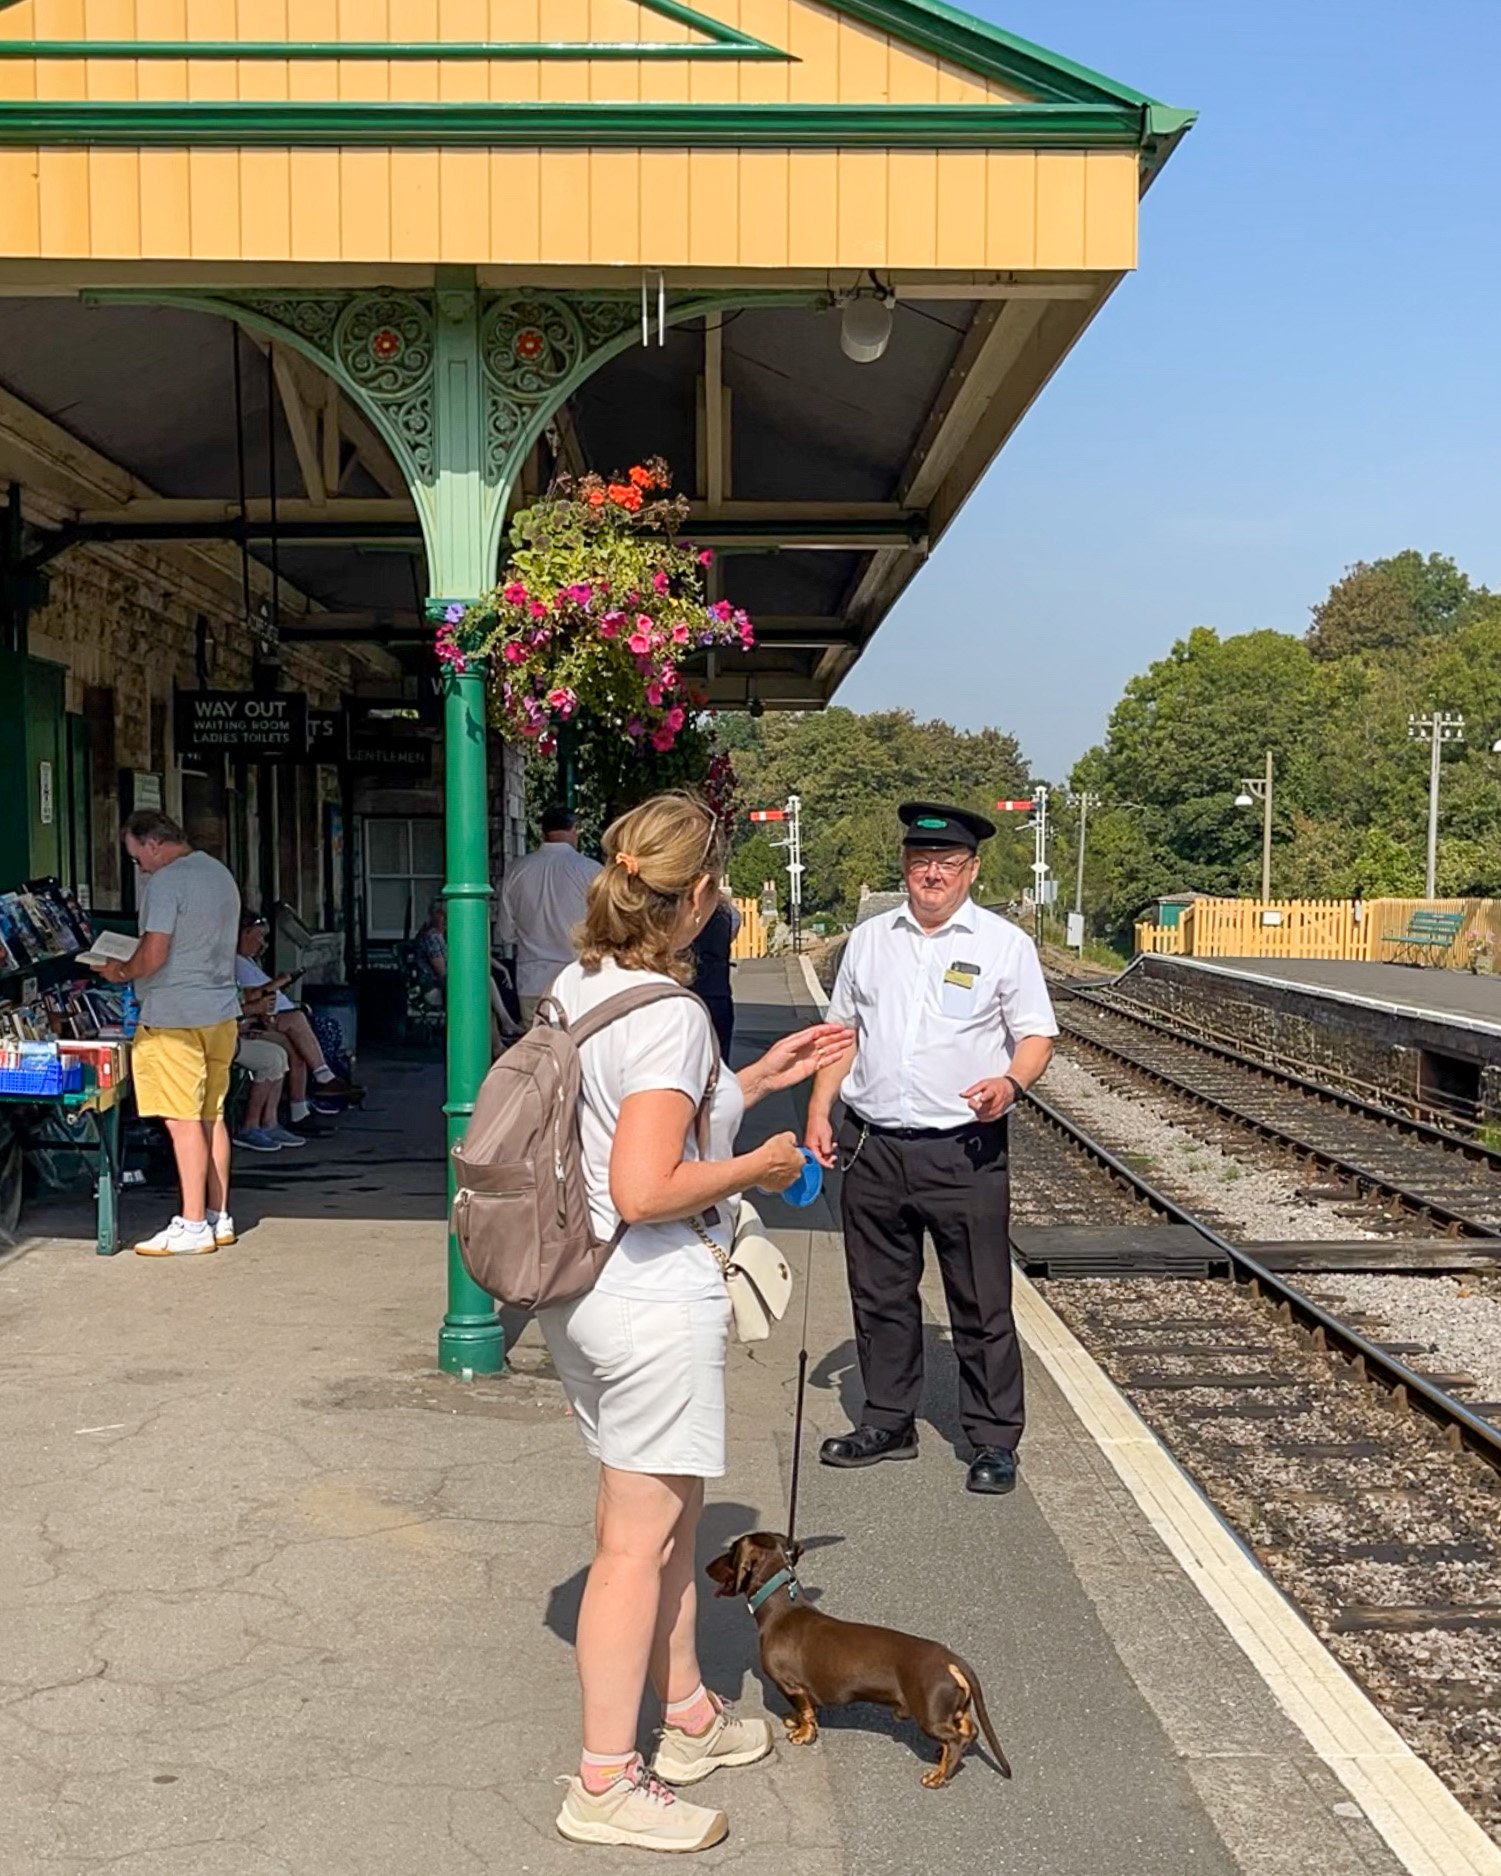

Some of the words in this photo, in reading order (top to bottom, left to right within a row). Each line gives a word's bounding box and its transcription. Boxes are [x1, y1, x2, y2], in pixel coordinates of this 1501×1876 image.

[193, 700, 238, 718] WAY
[244, 700, 287, 718] OUT
[193, 720, 247, 730] WAITING
[251, 720, 290, 731] ROOM
[193, 732, 239, 743] LADIES
[241, 732, 290, 744] TOILETS
